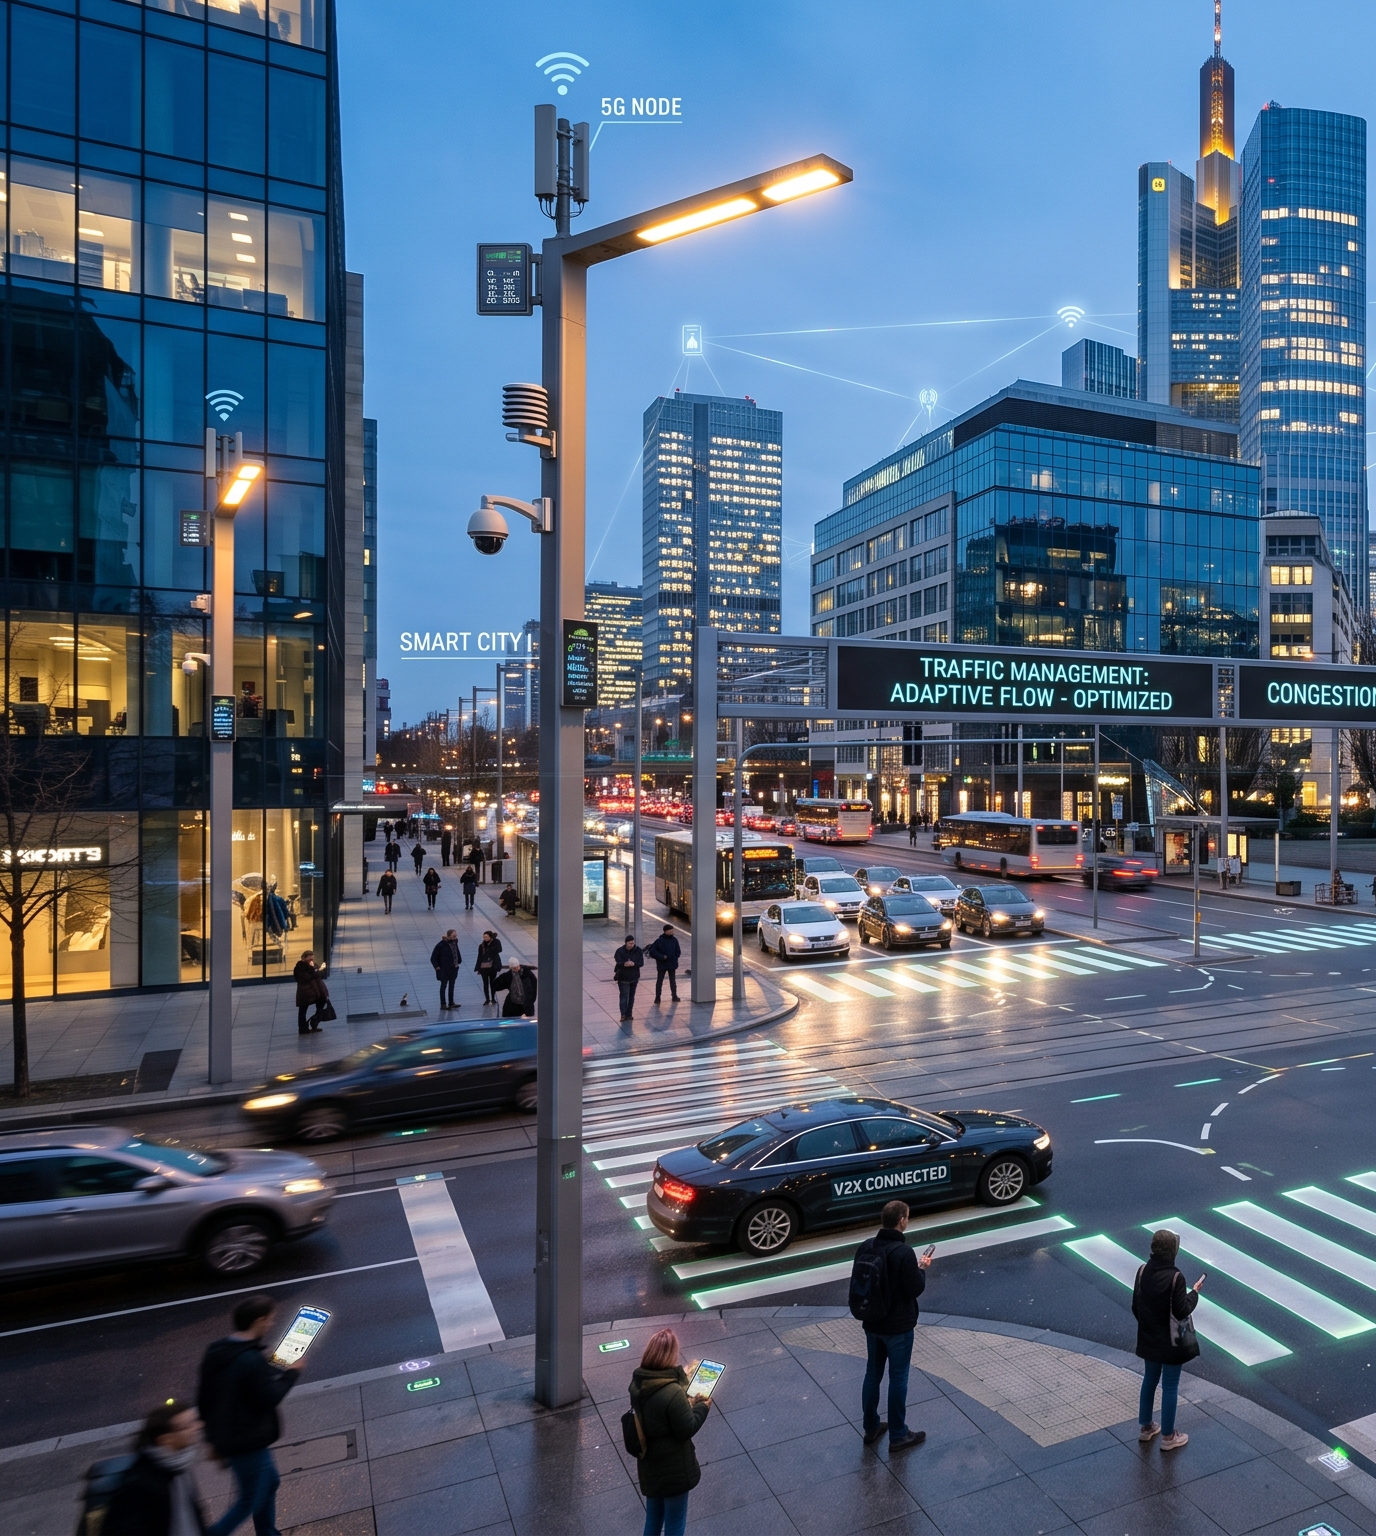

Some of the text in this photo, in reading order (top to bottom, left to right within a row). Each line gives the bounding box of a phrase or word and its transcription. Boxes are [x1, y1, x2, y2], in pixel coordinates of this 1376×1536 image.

[920, 658, 1149, 685] TRAFFIC MANAGEMENT:
[890, 683, 993, 705] ADAPTIVE
[1000, 686, 1054, 707] FLOW
[1073, 689, 1172, 710] OPTIMIZED
[834, 1165, 947, 1196] V2X CONNECTED
